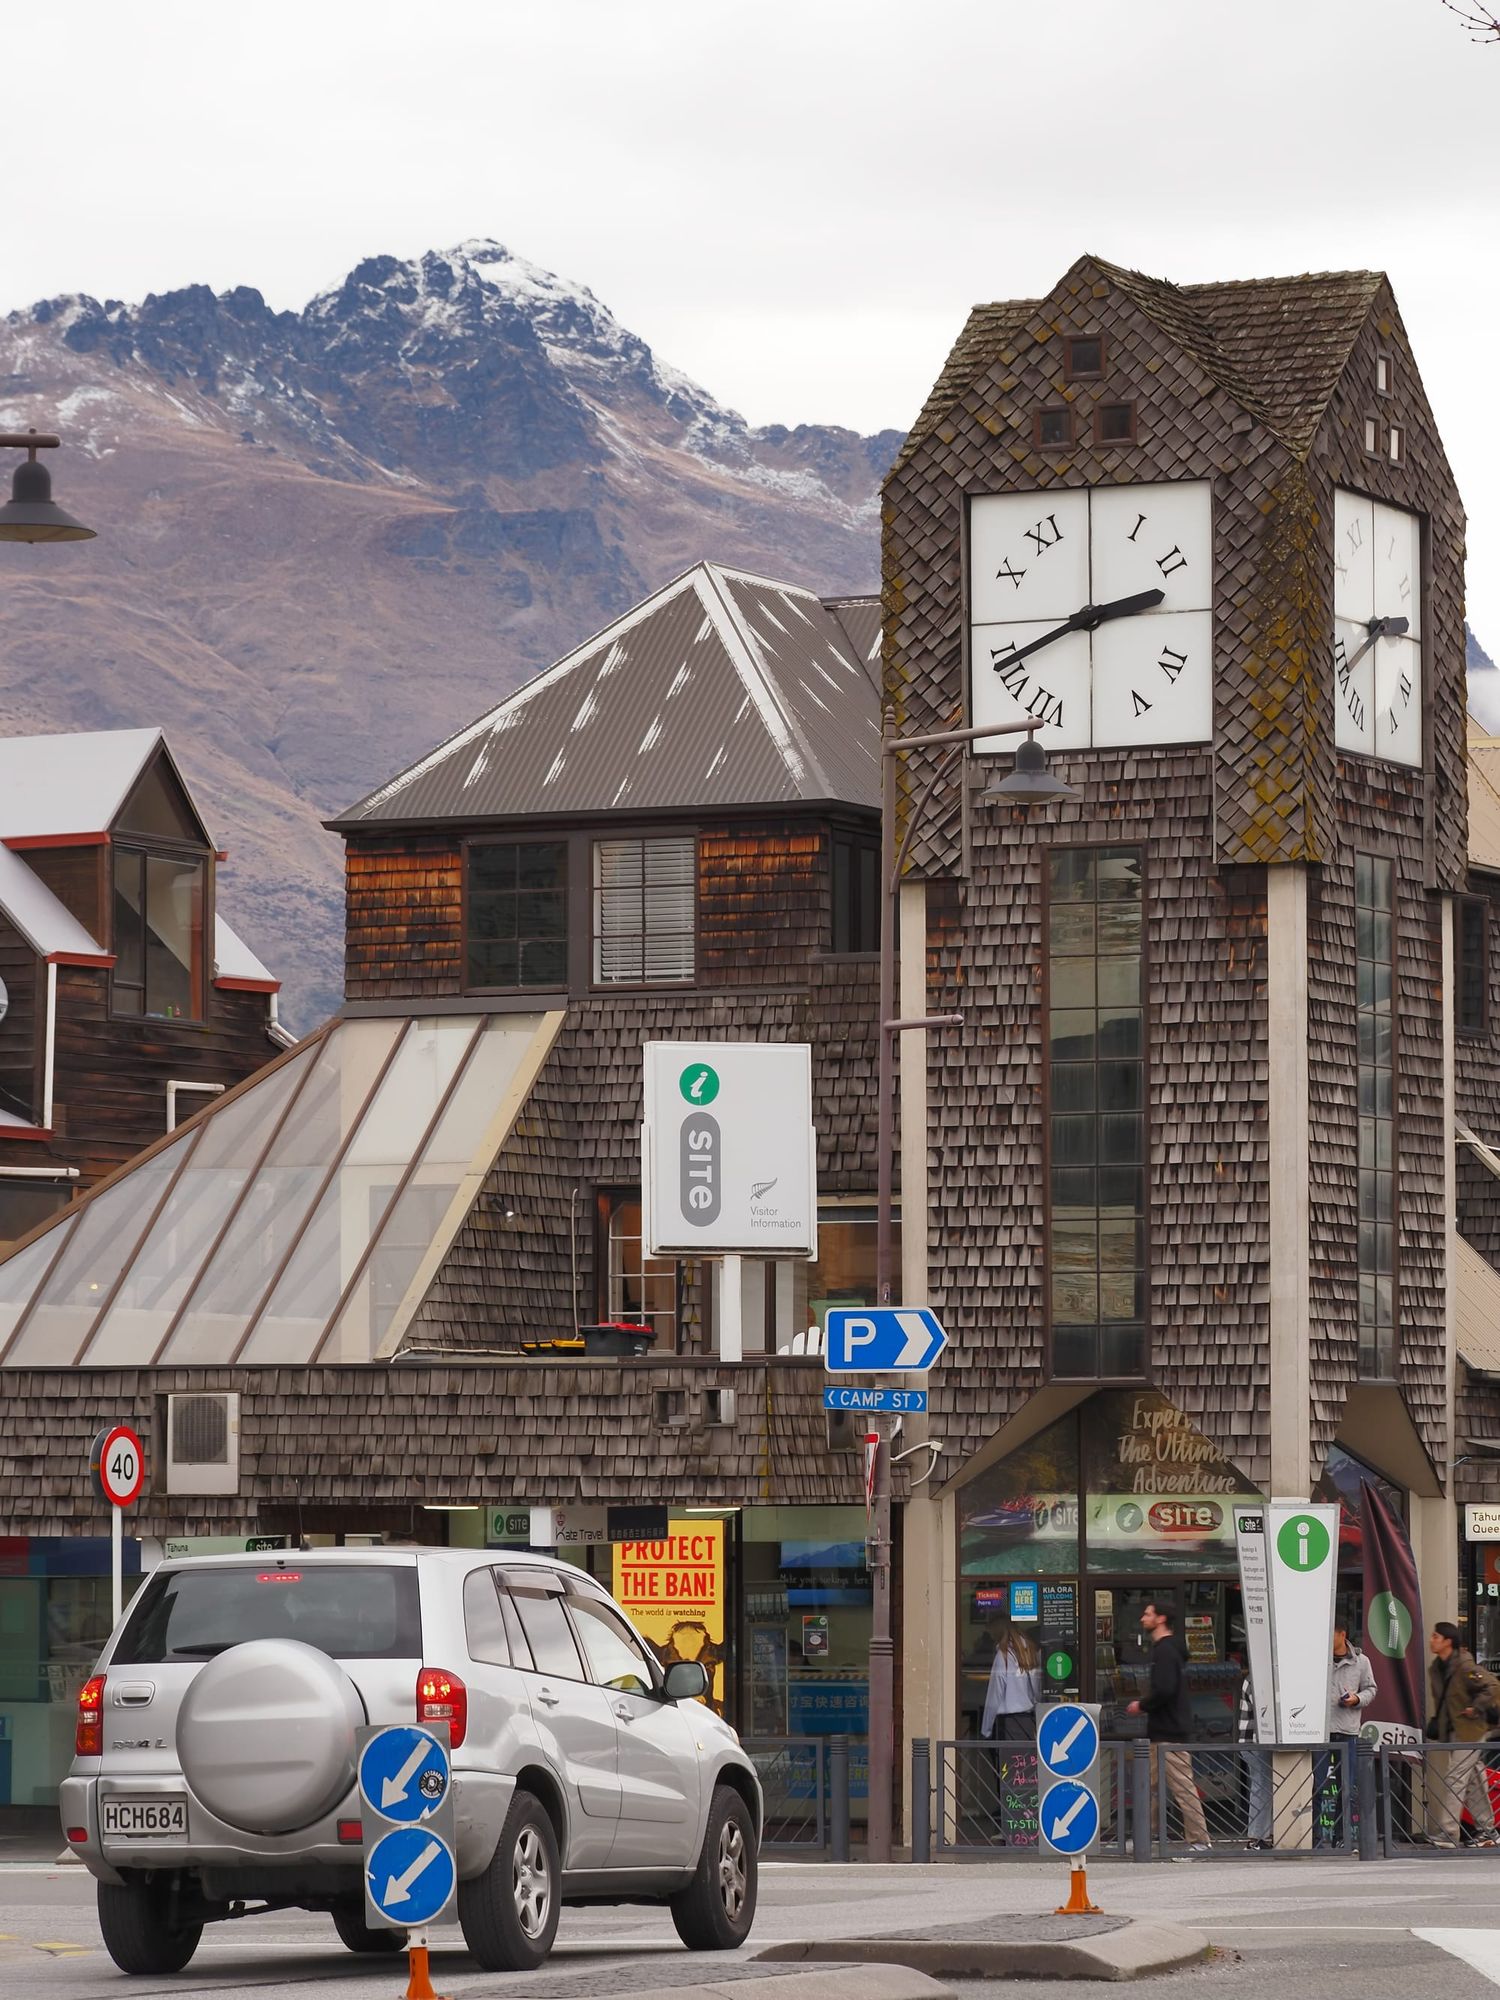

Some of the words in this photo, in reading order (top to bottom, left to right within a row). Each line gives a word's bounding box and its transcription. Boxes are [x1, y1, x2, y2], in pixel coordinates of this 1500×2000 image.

[1023, 514, 1064, 557] XI
[1128, 514, 1147, 542] I
[996, 557, 1027, 589] X
[1156, 545, 1188, 579] II
[1158, 645, 1188, 685] IV
[1025, 686, 1064, 728] VII
[1131, 689, 1153, 718] V
[751, 1206, 778, 1216] Visitor
[751, 1219, 802, 1228] Information
[844, 1318, 876, 1362] P
[840, 1390, 884, 1407] CAMP
[892, 1393, 911, 1408] ST
[1117, 1434, 1150, 1463] The
[111, 1454, 134, 1481] 40
[1132, 1464, 1236, 1494] Adventure
[555, 1527, 578, 1541] Kate
[580, 1528, 604, 1540] Travel
[621, 1535, 716, 1561] PROTECT
[621, 1572, 659, 1597] THE
[666, 1572, 715, 1597] BAN!
[630, 1608, 644, 1616] The
[645, 1608, 664, 1616] world
[673, 1609, 706, 1617] watching
[1014, 1596, 1034, 1605] HERE
[1381, 1727, 1418, 1745] site
[106, 1807, 183, 1829] HCH684
